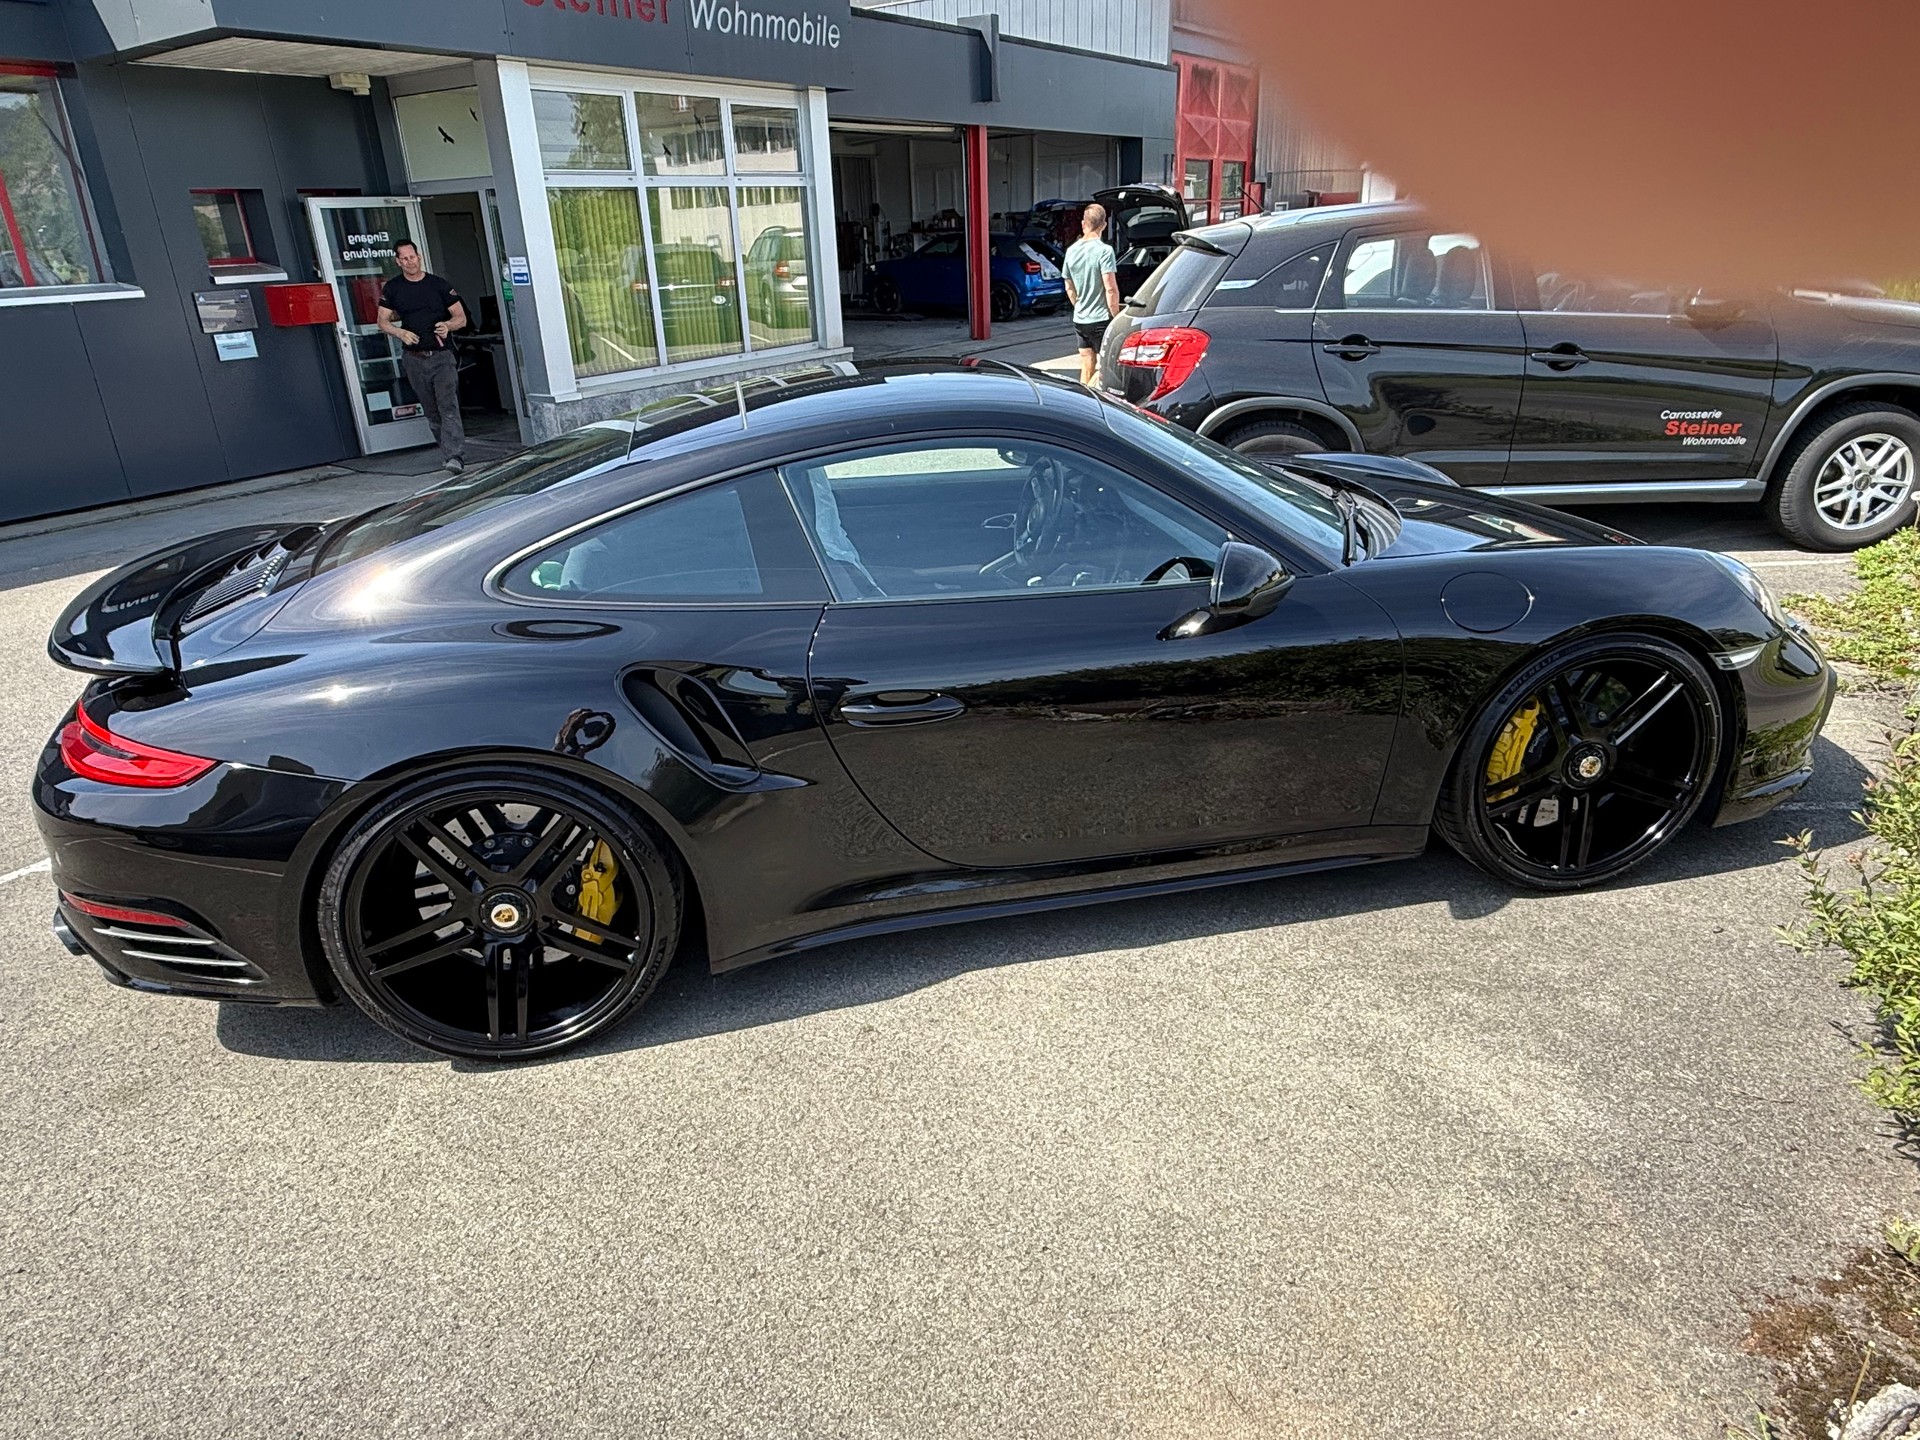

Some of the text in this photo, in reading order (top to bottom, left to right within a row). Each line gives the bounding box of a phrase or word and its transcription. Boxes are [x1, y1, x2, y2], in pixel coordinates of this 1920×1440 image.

[521, 0, 841, 49] ener Wohnmobile
[1660, 409, 1722, 419] Carrosserie
[1664, 420, 1743, 435] Steiner
[1682, 436, 1747, 446] Wohnmobile
